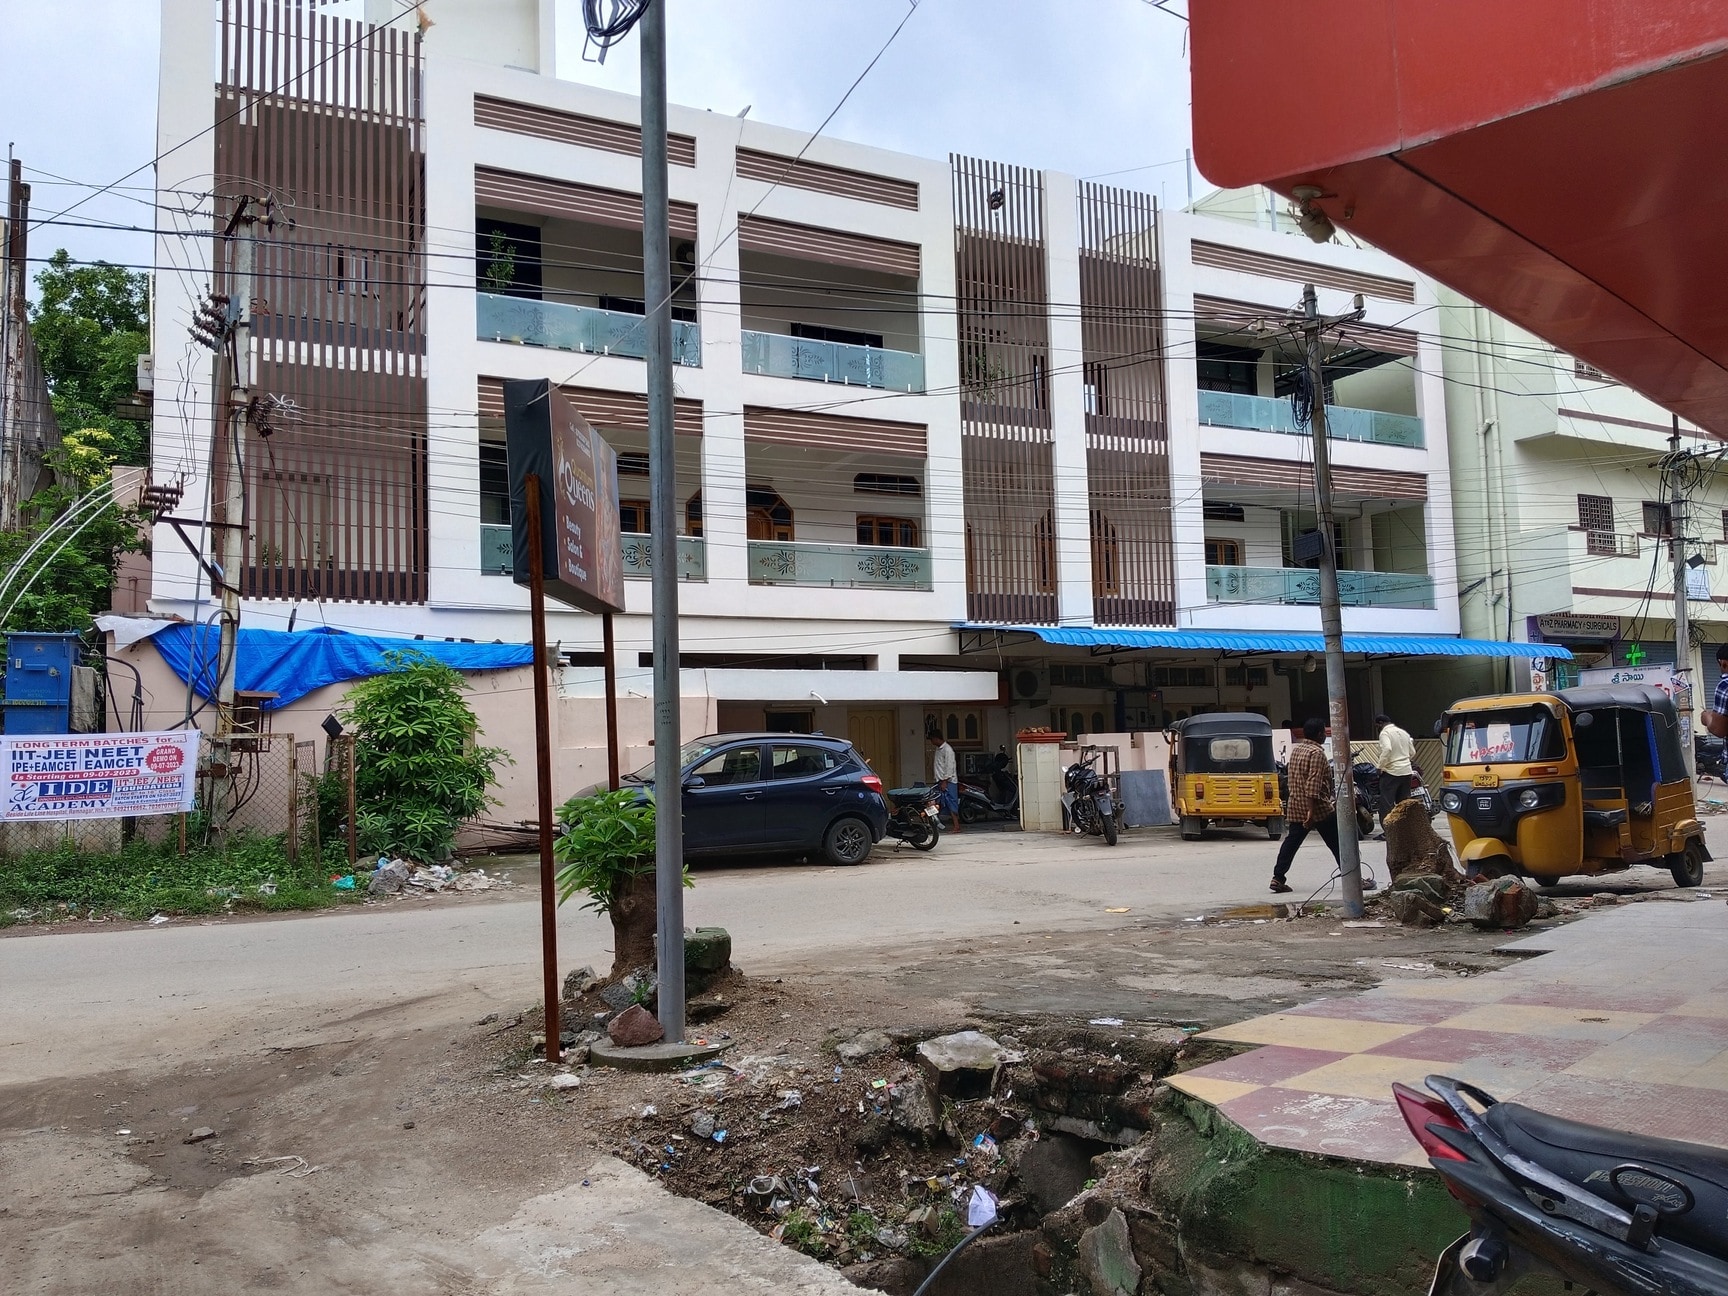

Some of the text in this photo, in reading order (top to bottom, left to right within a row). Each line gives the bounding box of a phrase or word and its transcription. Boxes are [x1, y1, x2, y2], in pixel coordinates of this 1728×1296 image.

[564, 461, 595, 512] Queens
[565, 514, 582, 540] Beauty
[567, 536, 580, 557] Salon
[568, 558, 587, 582] Boutique
[1553, 619, 1582, 630] PHARMACY
[1586, 621, 1617, 631] SURGICALS
[15, 741, 50, 749] LONG
[53, 740, 90, 748] TERM
[94, 738, 149, 746] BATCHES
[12, 747, 143, 761] IIT-JEE NEET
[12, 758, 144, 772] IPE+EAMCET EAMCET
[26, 773, 66, 781] Starting
[116, 777, 149, 787] IIT-JEE
[157, 775, 182, 784] NEET
[45, 781, 108, 795] IDE
[118, 783, 179, 792] FOUNDATION
[11, 800, 109, 811] ACADEMY
